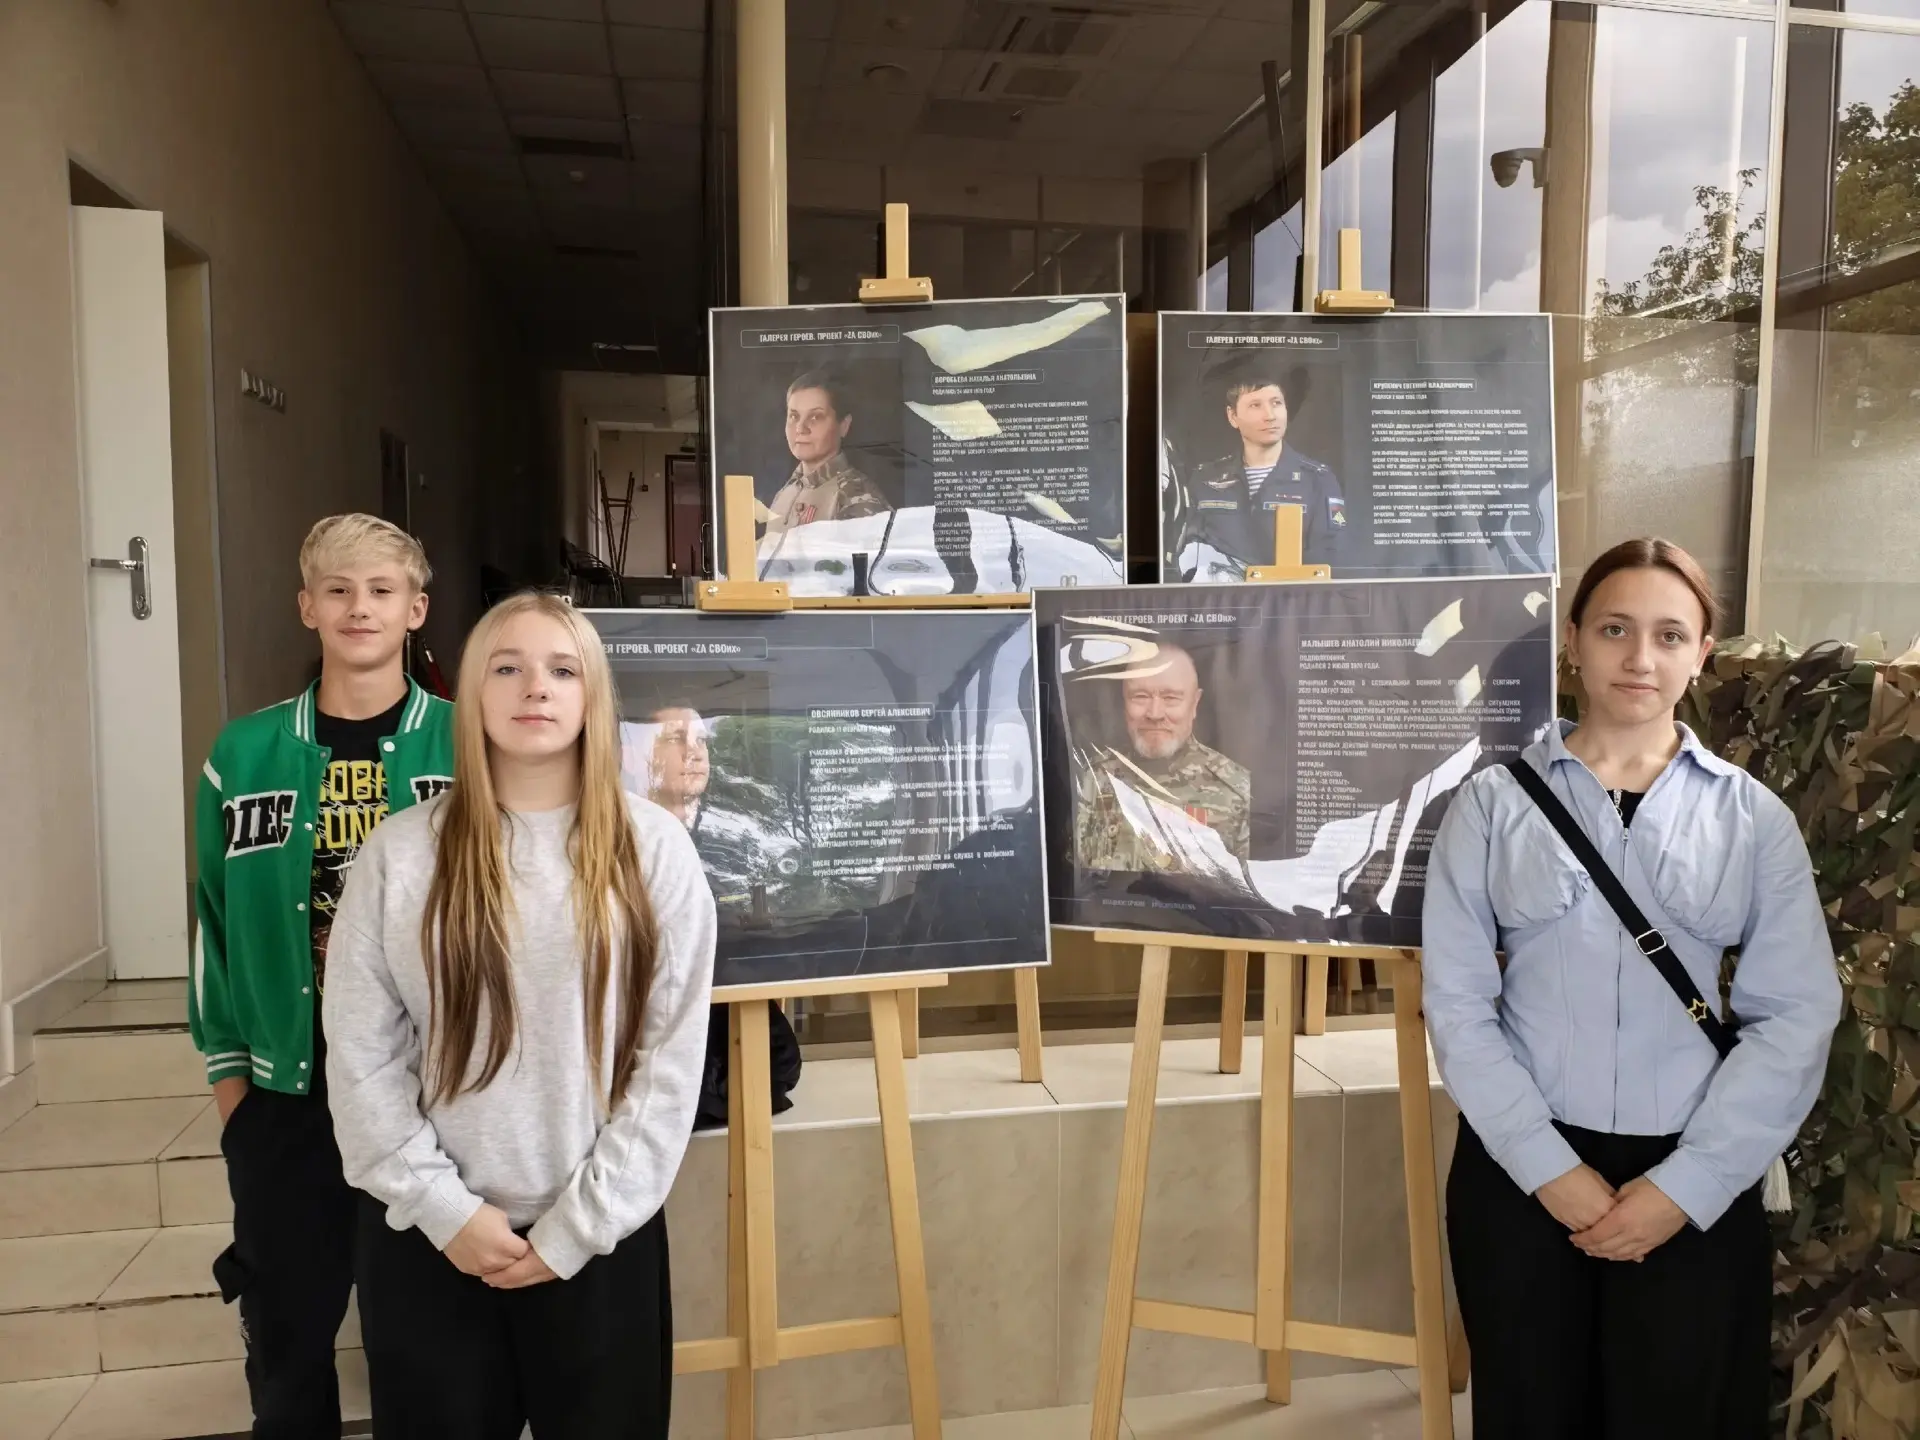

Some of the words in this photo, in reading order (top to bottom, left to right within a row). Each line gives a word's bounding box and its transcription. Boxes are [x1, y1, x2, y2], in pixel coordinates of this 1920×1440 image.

[760, 334, 788, 342] ГАЛЕРЕЯ
[790, 333, 816, 341] ГЕРОЕВ.
[818, 332, 842, 340] ПРОЕКТ
[1206, 336, 1233, 344] ГАЛЕРЕЯ
[1124, 615, 1154, 624] ГЕРОЕВ.
[1158, 614, 1188, 624] ПРОЕКТ
[1190, 614, 1204, 623] «ZA
[1341, 638, 1380, 647] АНАТОЛИЙ
[616, 644, 651, 654] ГЕРОЕВ.
[654, 644, 688, 653] ПРОЕКТ
[691, 644, 706, 653] «ZA
[709, 644, 741, 653] СВОих»
[811, 709, 859, 718] ОВСЯННИКОВ
[861, 707, 886, 716] СЕРГЕЙ
[888, 708, 931, 716] АЛЕКСЕЕВИЧ
